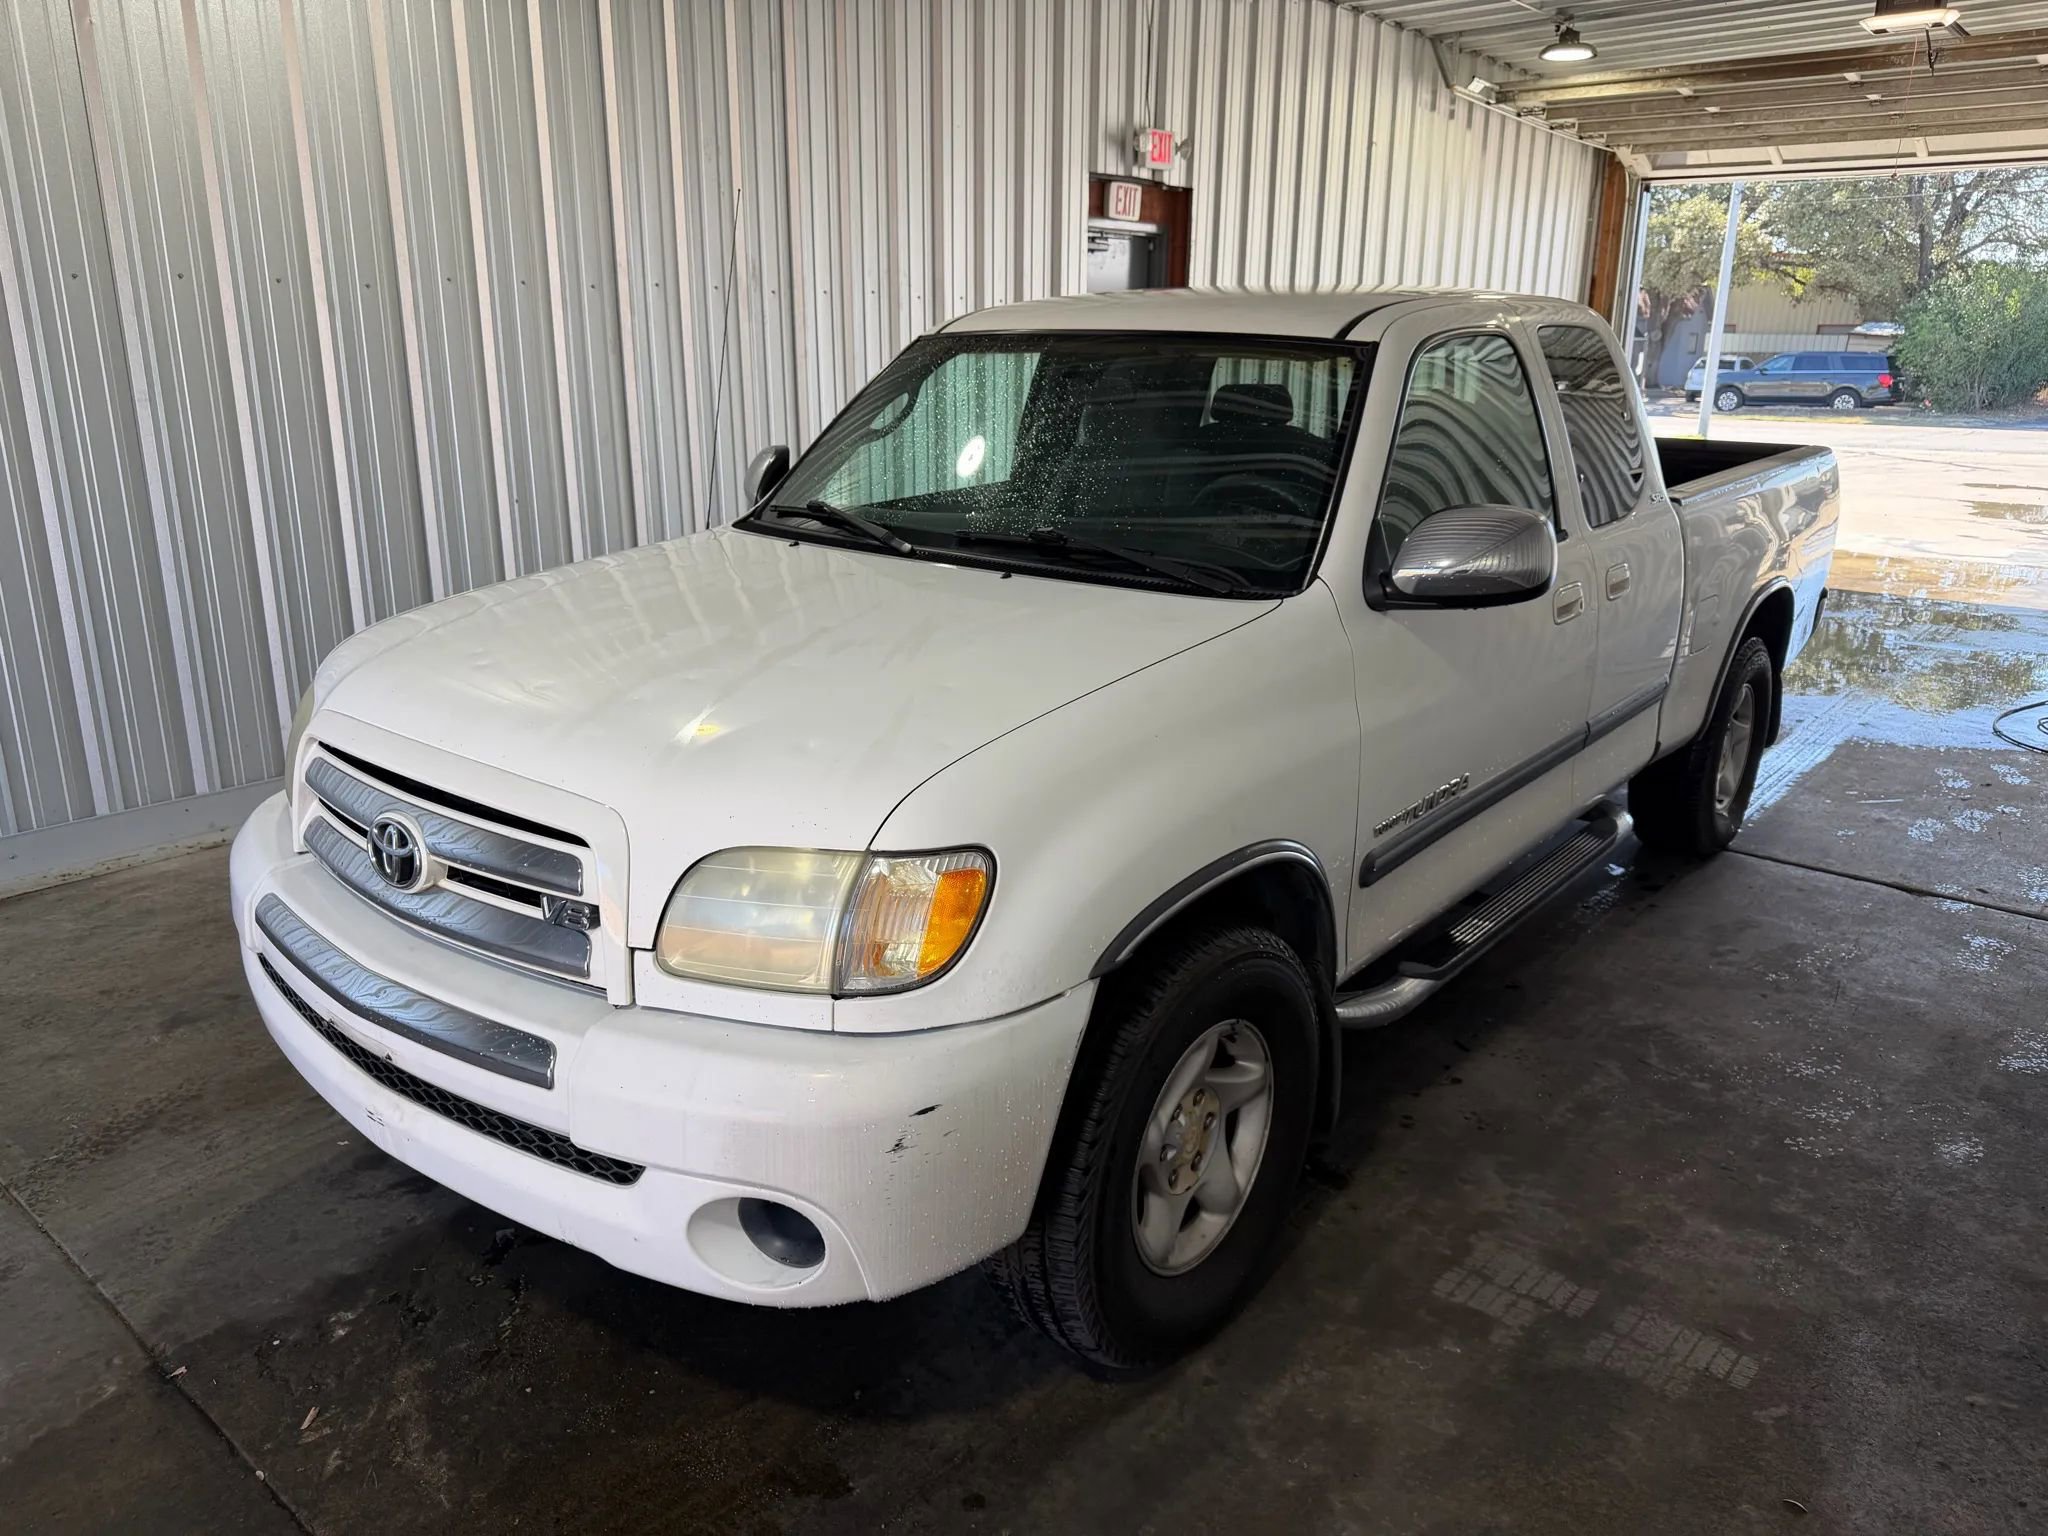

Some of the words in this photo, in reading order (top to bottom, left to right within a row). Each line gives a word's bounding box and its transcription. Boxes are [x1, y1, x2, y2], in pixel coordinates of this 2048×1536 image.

[1151, 130, 1173, 164] EXIT
[1115, 184, 1138, 218] EXIT
[541, 893, 591, 931] V8
